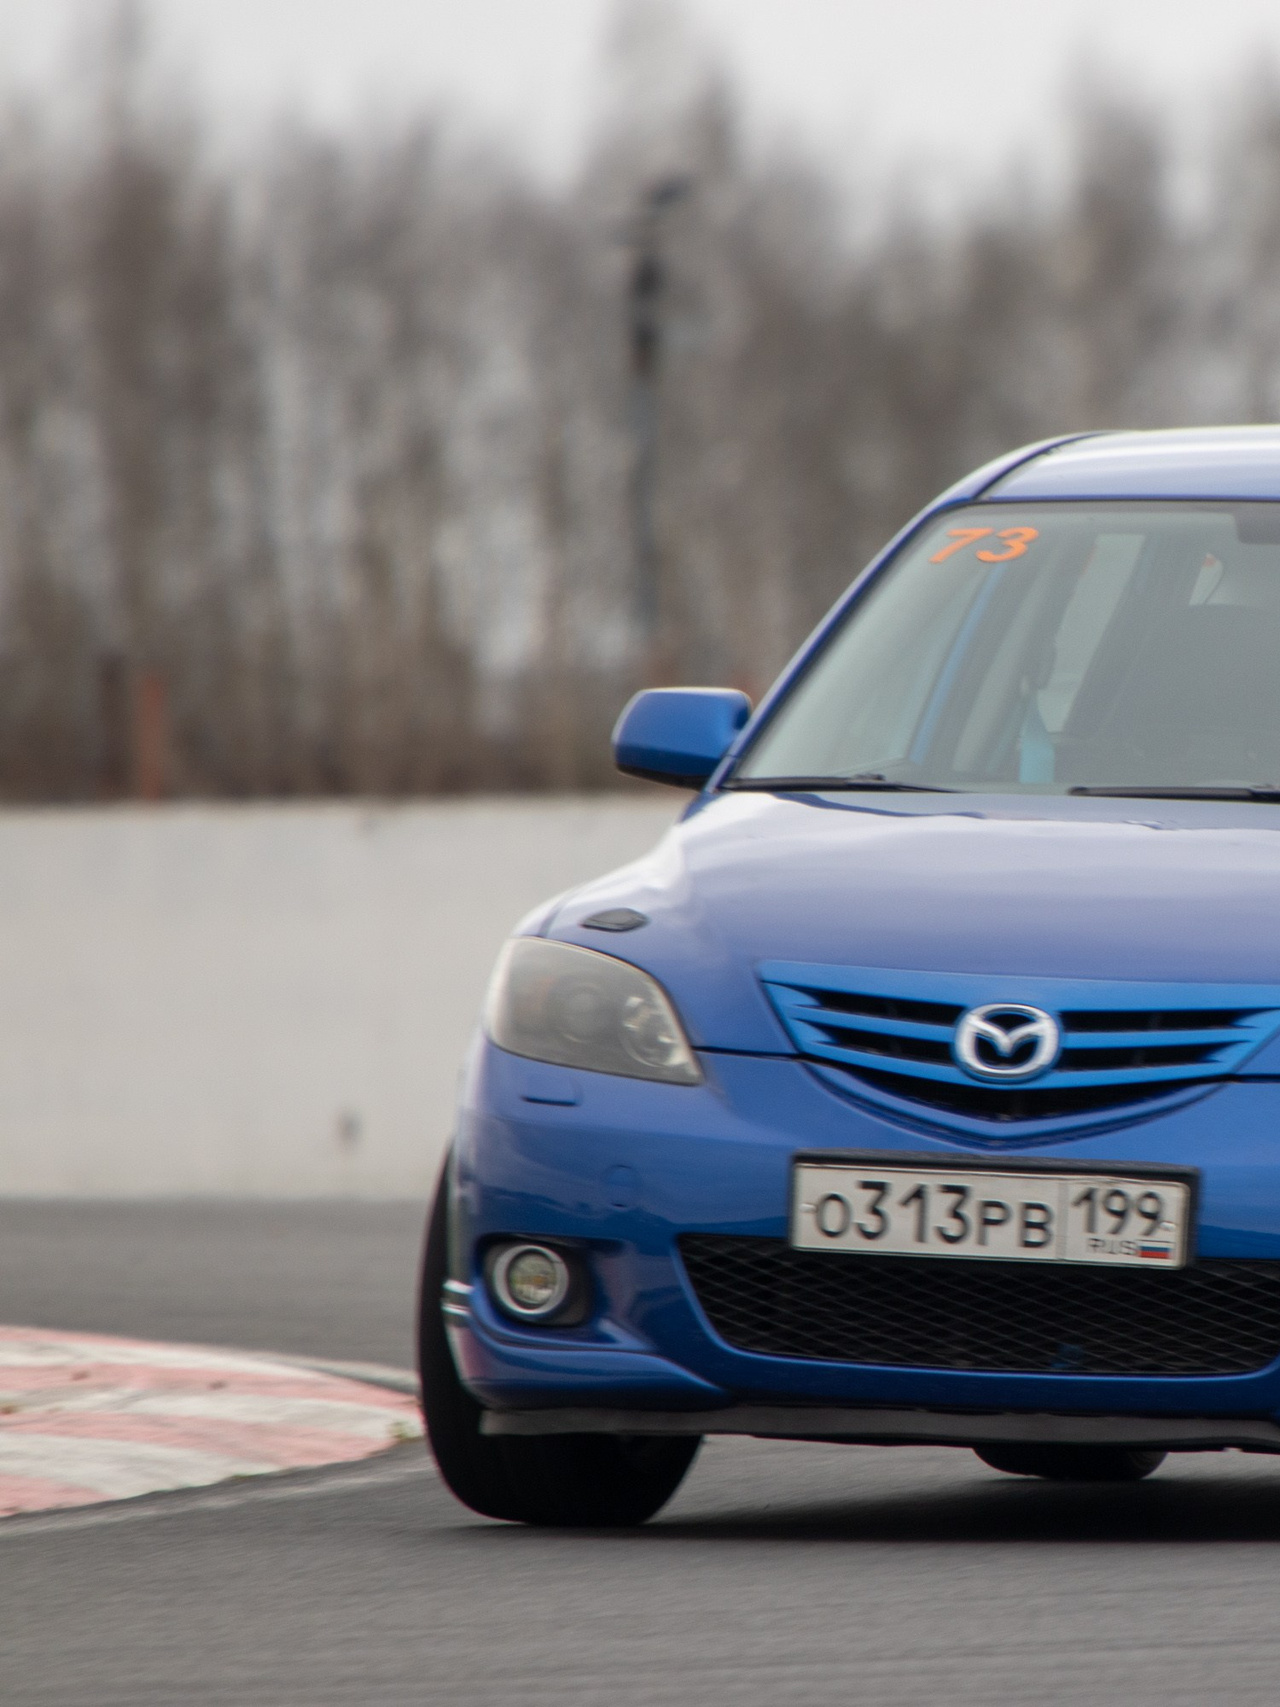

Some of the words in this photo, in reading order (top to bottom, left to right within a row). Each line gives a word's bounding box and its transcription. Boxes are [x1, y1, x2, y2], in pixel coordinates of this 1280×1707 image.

[929, 526, 1039, 563] 73
[1071, 1187, 1164, 1237] 199
[1087, 1237, 1138, 1256] RUS
